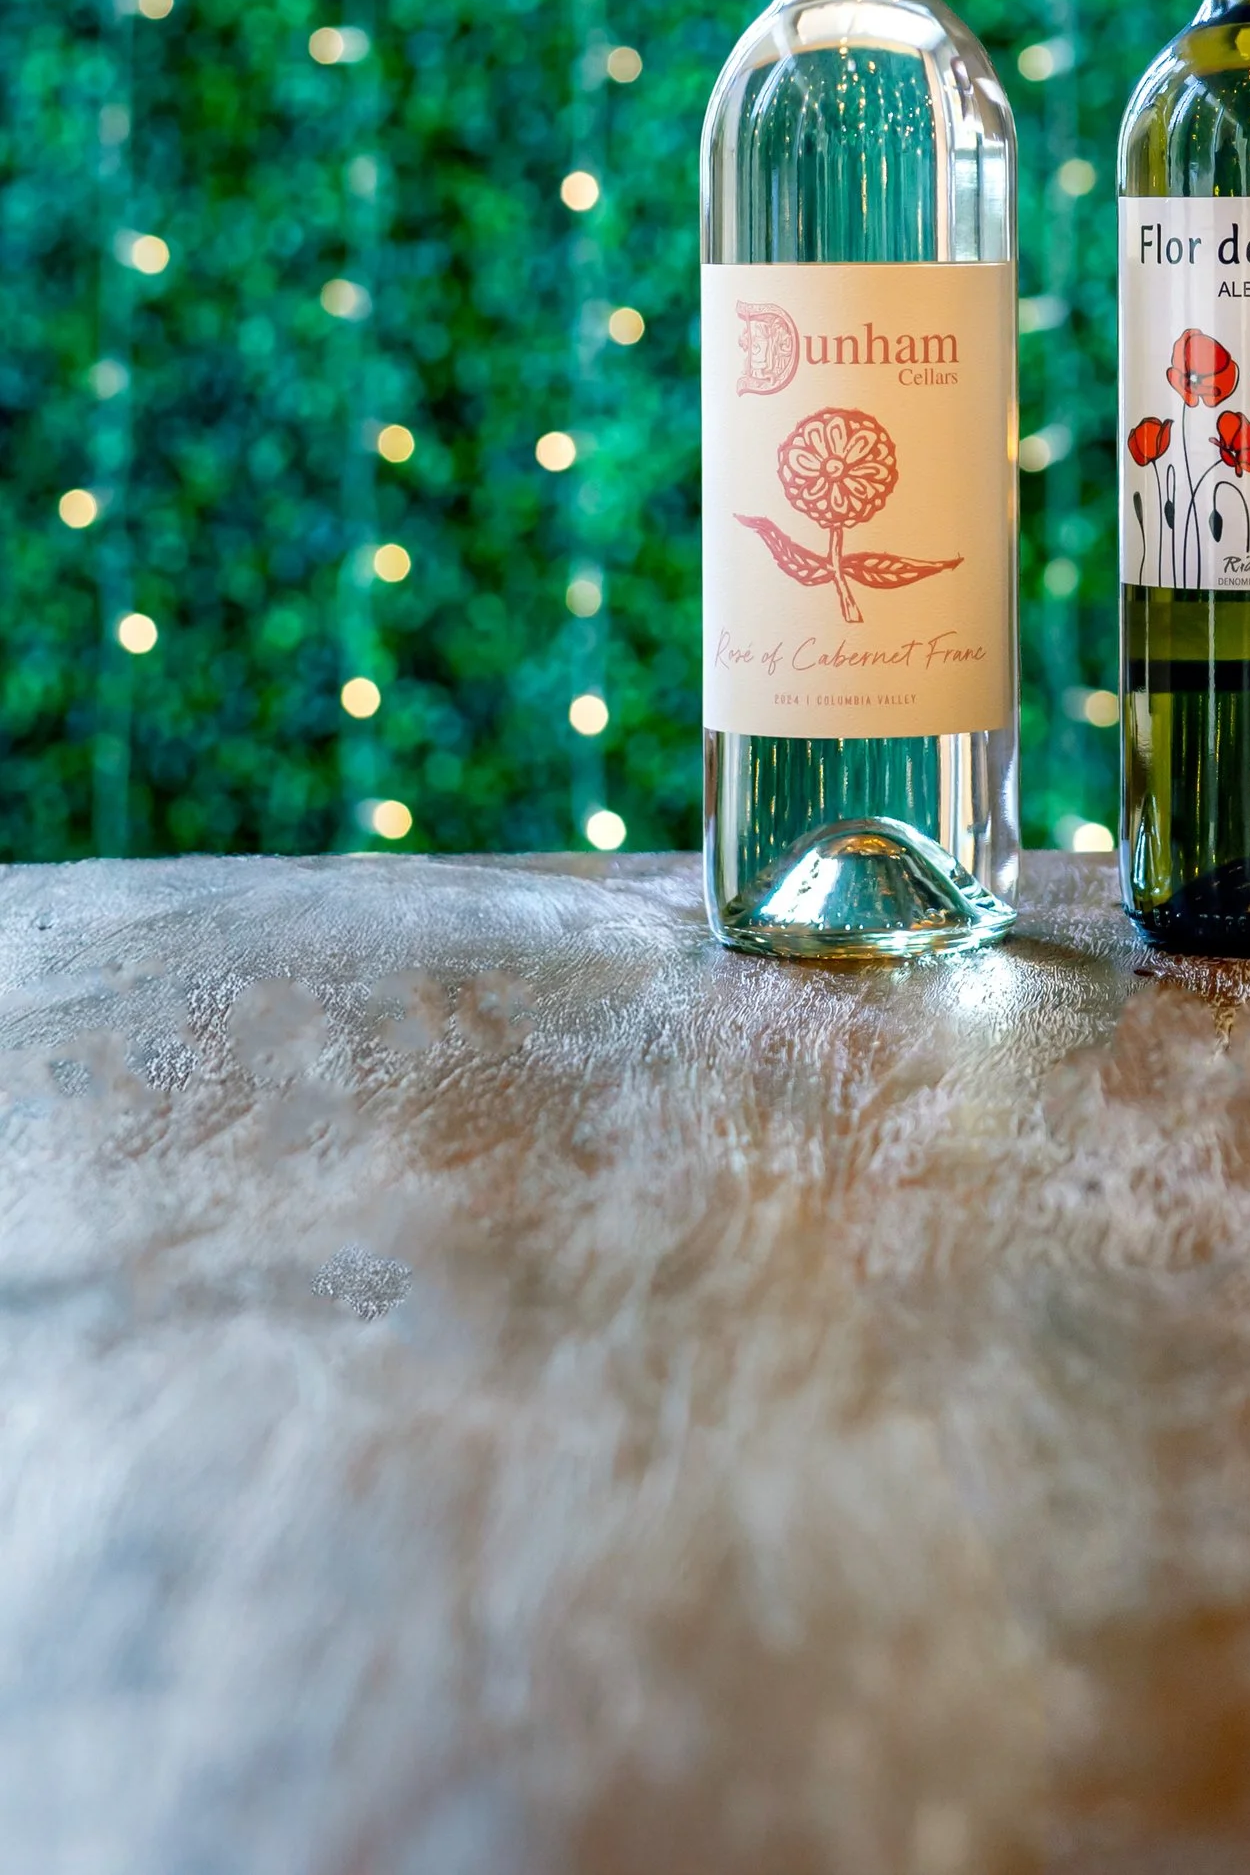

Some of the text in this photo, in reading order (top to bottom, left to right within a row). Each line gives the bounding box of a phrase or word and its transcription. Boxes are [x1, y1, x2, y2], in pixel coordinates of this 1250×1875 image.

[1141, 223, 1202, 264] Flor
[736, 300, 959, 397] Dunham
[898, 368, 958, 386] Cellars
[714, 629, 987, 676] Rosé of Cabernet Franc
[774, 694, 916, 706] 2024 COLUMBIA VALLEY
